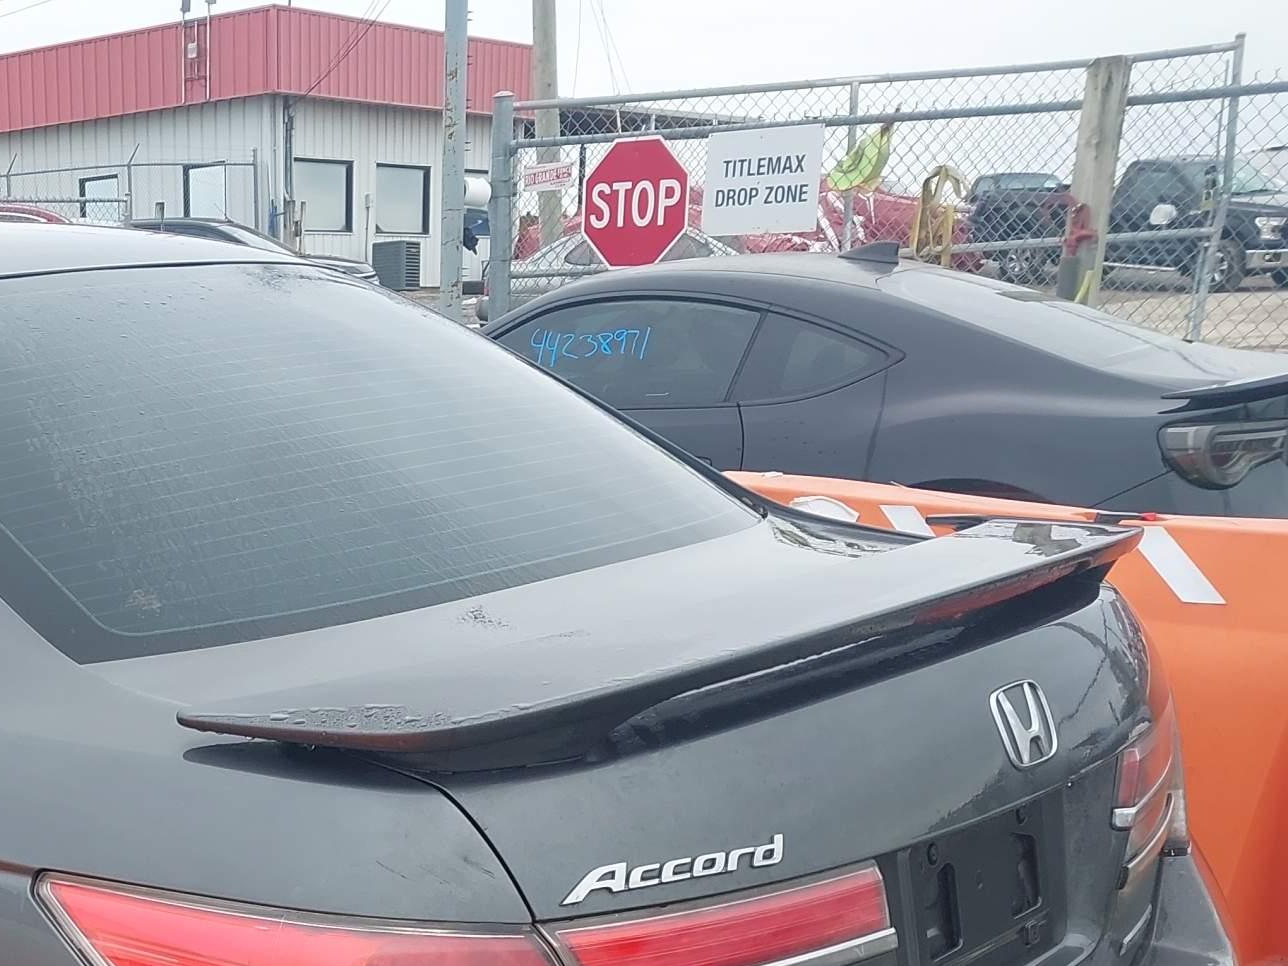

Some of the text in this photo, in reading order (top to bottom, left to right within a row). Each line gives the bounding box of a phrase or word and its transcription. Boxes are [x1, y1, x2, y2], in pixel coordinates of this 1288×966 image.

[723, 154, 806, 178] TITLEMAX
[589, 178, 682, 229] STOP
[714, 184, 809, 208] DROP ZONE
[531, 326, 651, 367] 44238971
[560, 833, 784, 906] Accord
